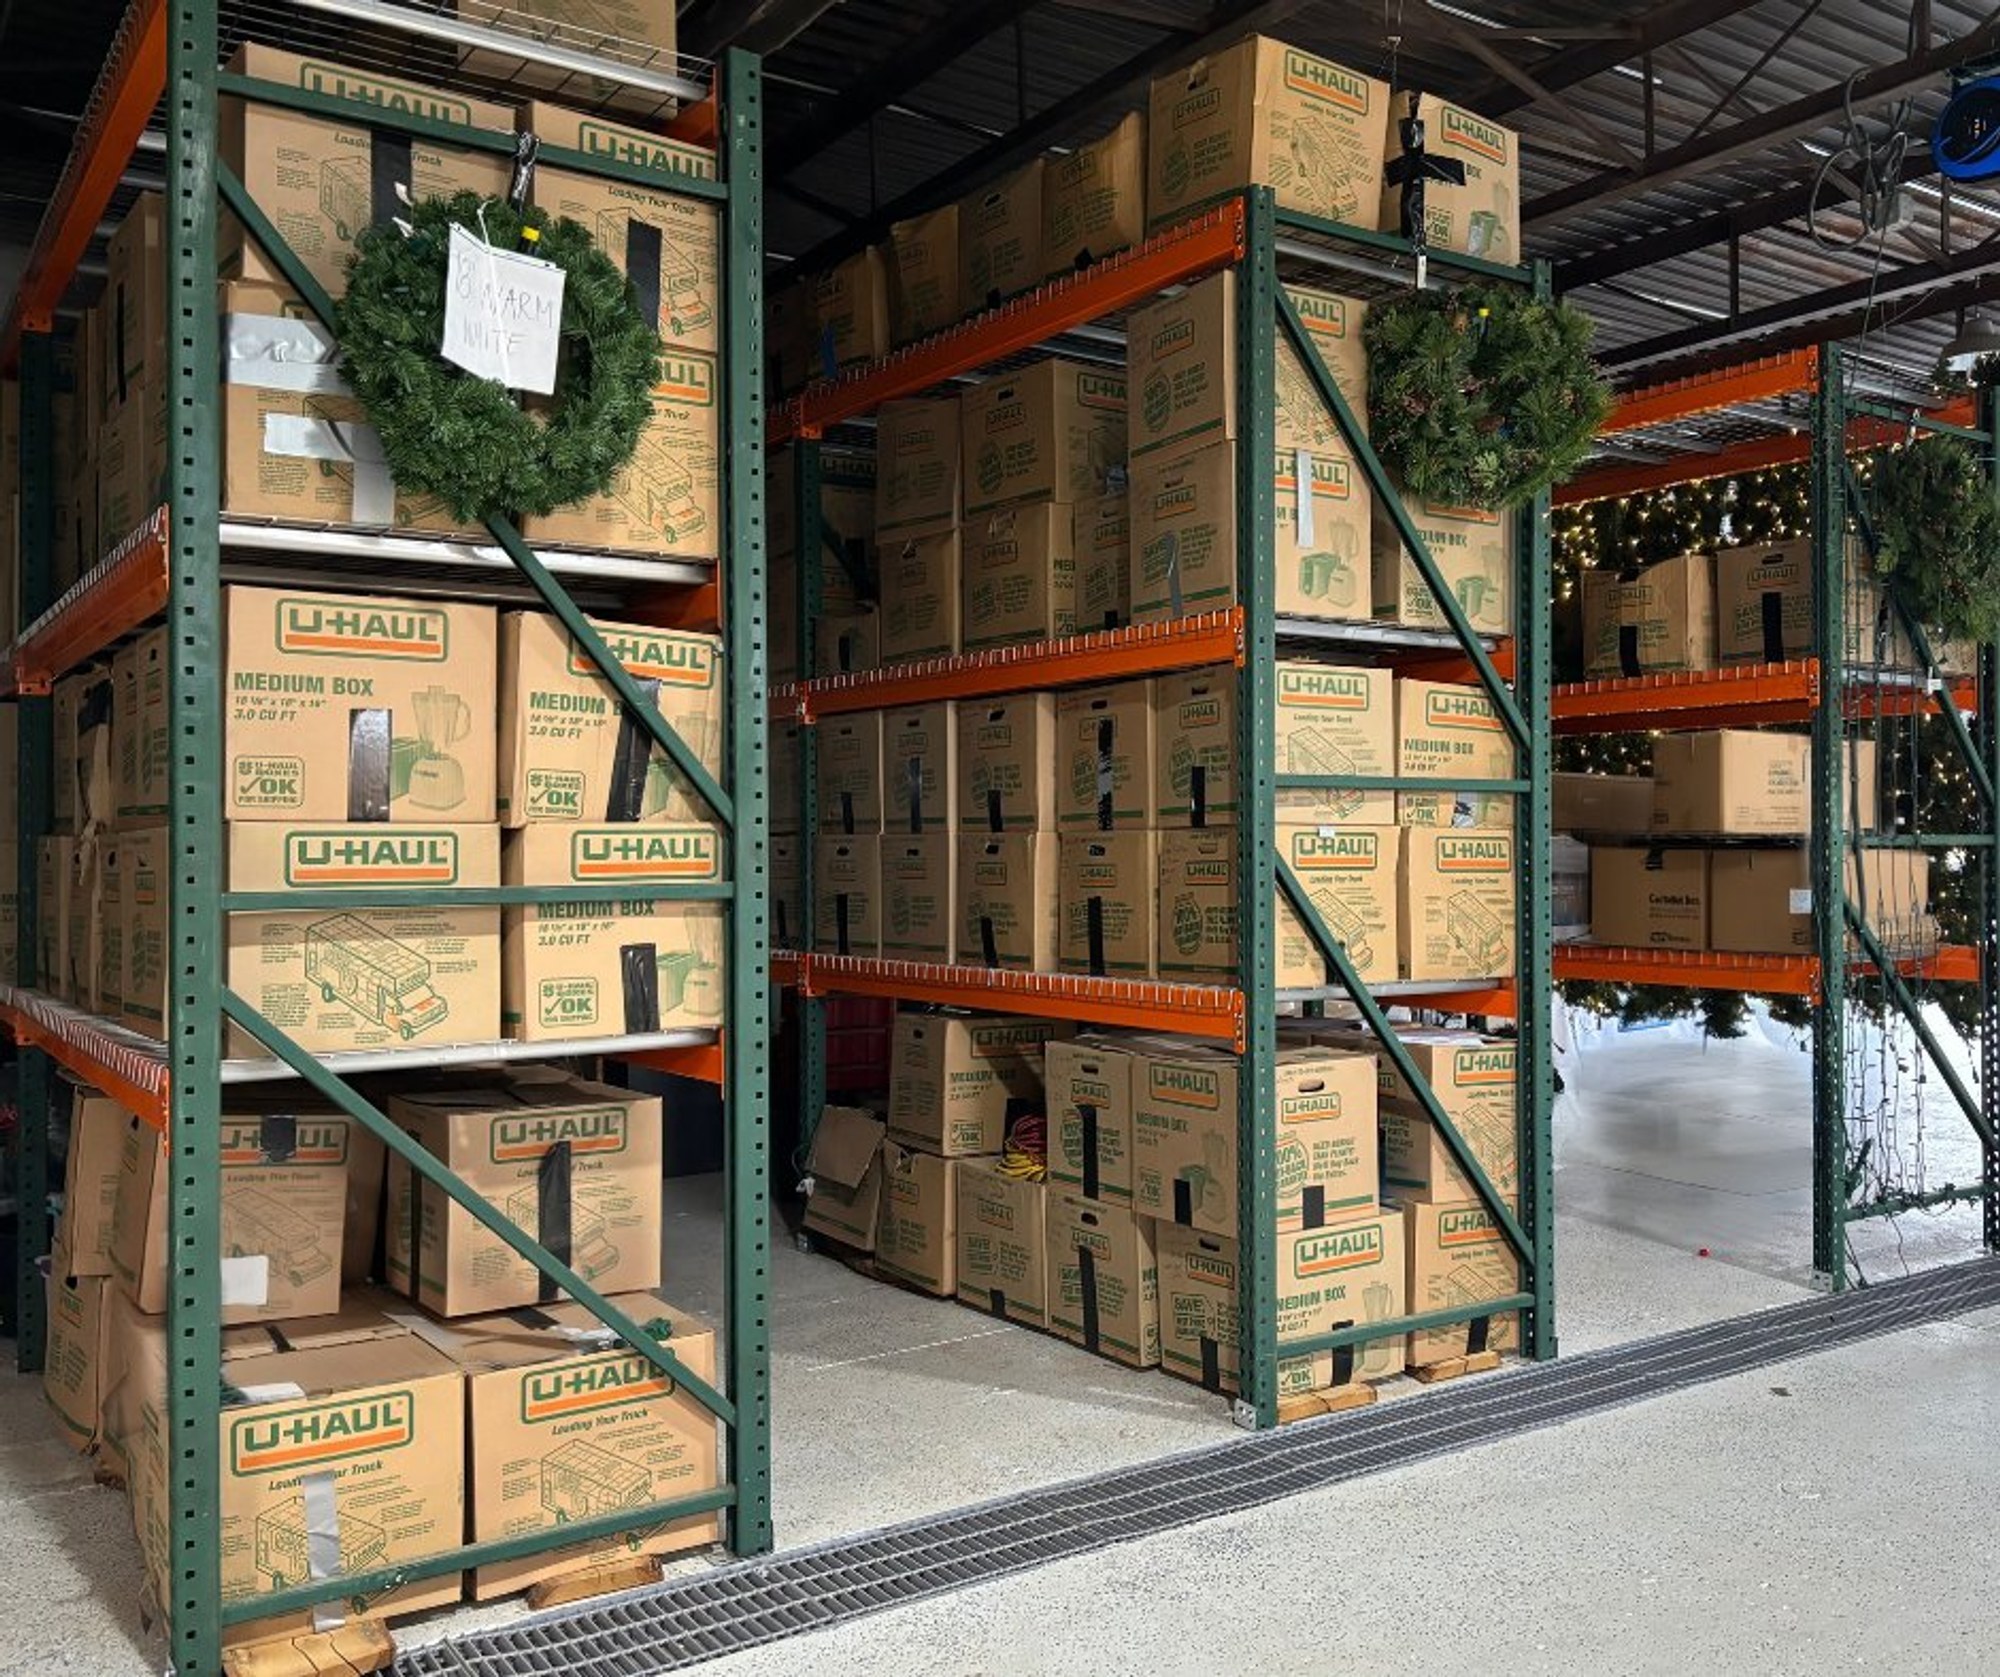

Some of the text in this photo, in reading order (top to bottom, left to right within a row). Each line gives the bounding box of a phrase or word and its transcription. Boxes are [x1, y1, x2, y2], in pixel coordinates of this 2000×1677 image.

[1291, 57, 1363, 100] U-HAUL
[1447, 112, 1500, 149] U-HAUL
[289, 608, 438, 641] U-HAUL
[234, 672, 373, 696] MEDIUM BOX
[1283, 675, 1363, 696] U-HAUL
[529, 692, 605, 714] MEDIUM
[259, 709, 277, 720] CU
[281, 711, 297, 720] FT
[568, 728, 582, 739] FT
[1404, 738, 1450, 752] MEDIUM
[260, 778, 297, 795] OK
[547, 790, 579, 807] OK
[298, 840, 448, 865] U-HAUL
[583, 838, 710, 860] U-HAUL
[1300, 837, 1373, 855] U-HAUL
[1442, 842, 1507, 859] U-HAUL
[538, 900, 655, 918] MEDIUM BOX
[576, 935, 590, 944] FT
[561, 998, 592, 1013] OK
[1460, 1052, 1514, 1071] U-HAU
[1154, 1069, 1213, 1093] U-HAUL
[1285, 1098, 1337, 1114] U-HAUL
[500, 1114, 618, 1144] U-HAUL
[1301, 1233, 1378, 1262] U-HAUL
[1325, 1285, 1346, 1301] BOX
[1292, 1370, 1310, 1384] OK
[244, 1402, 404, 1452] U-HAUL
